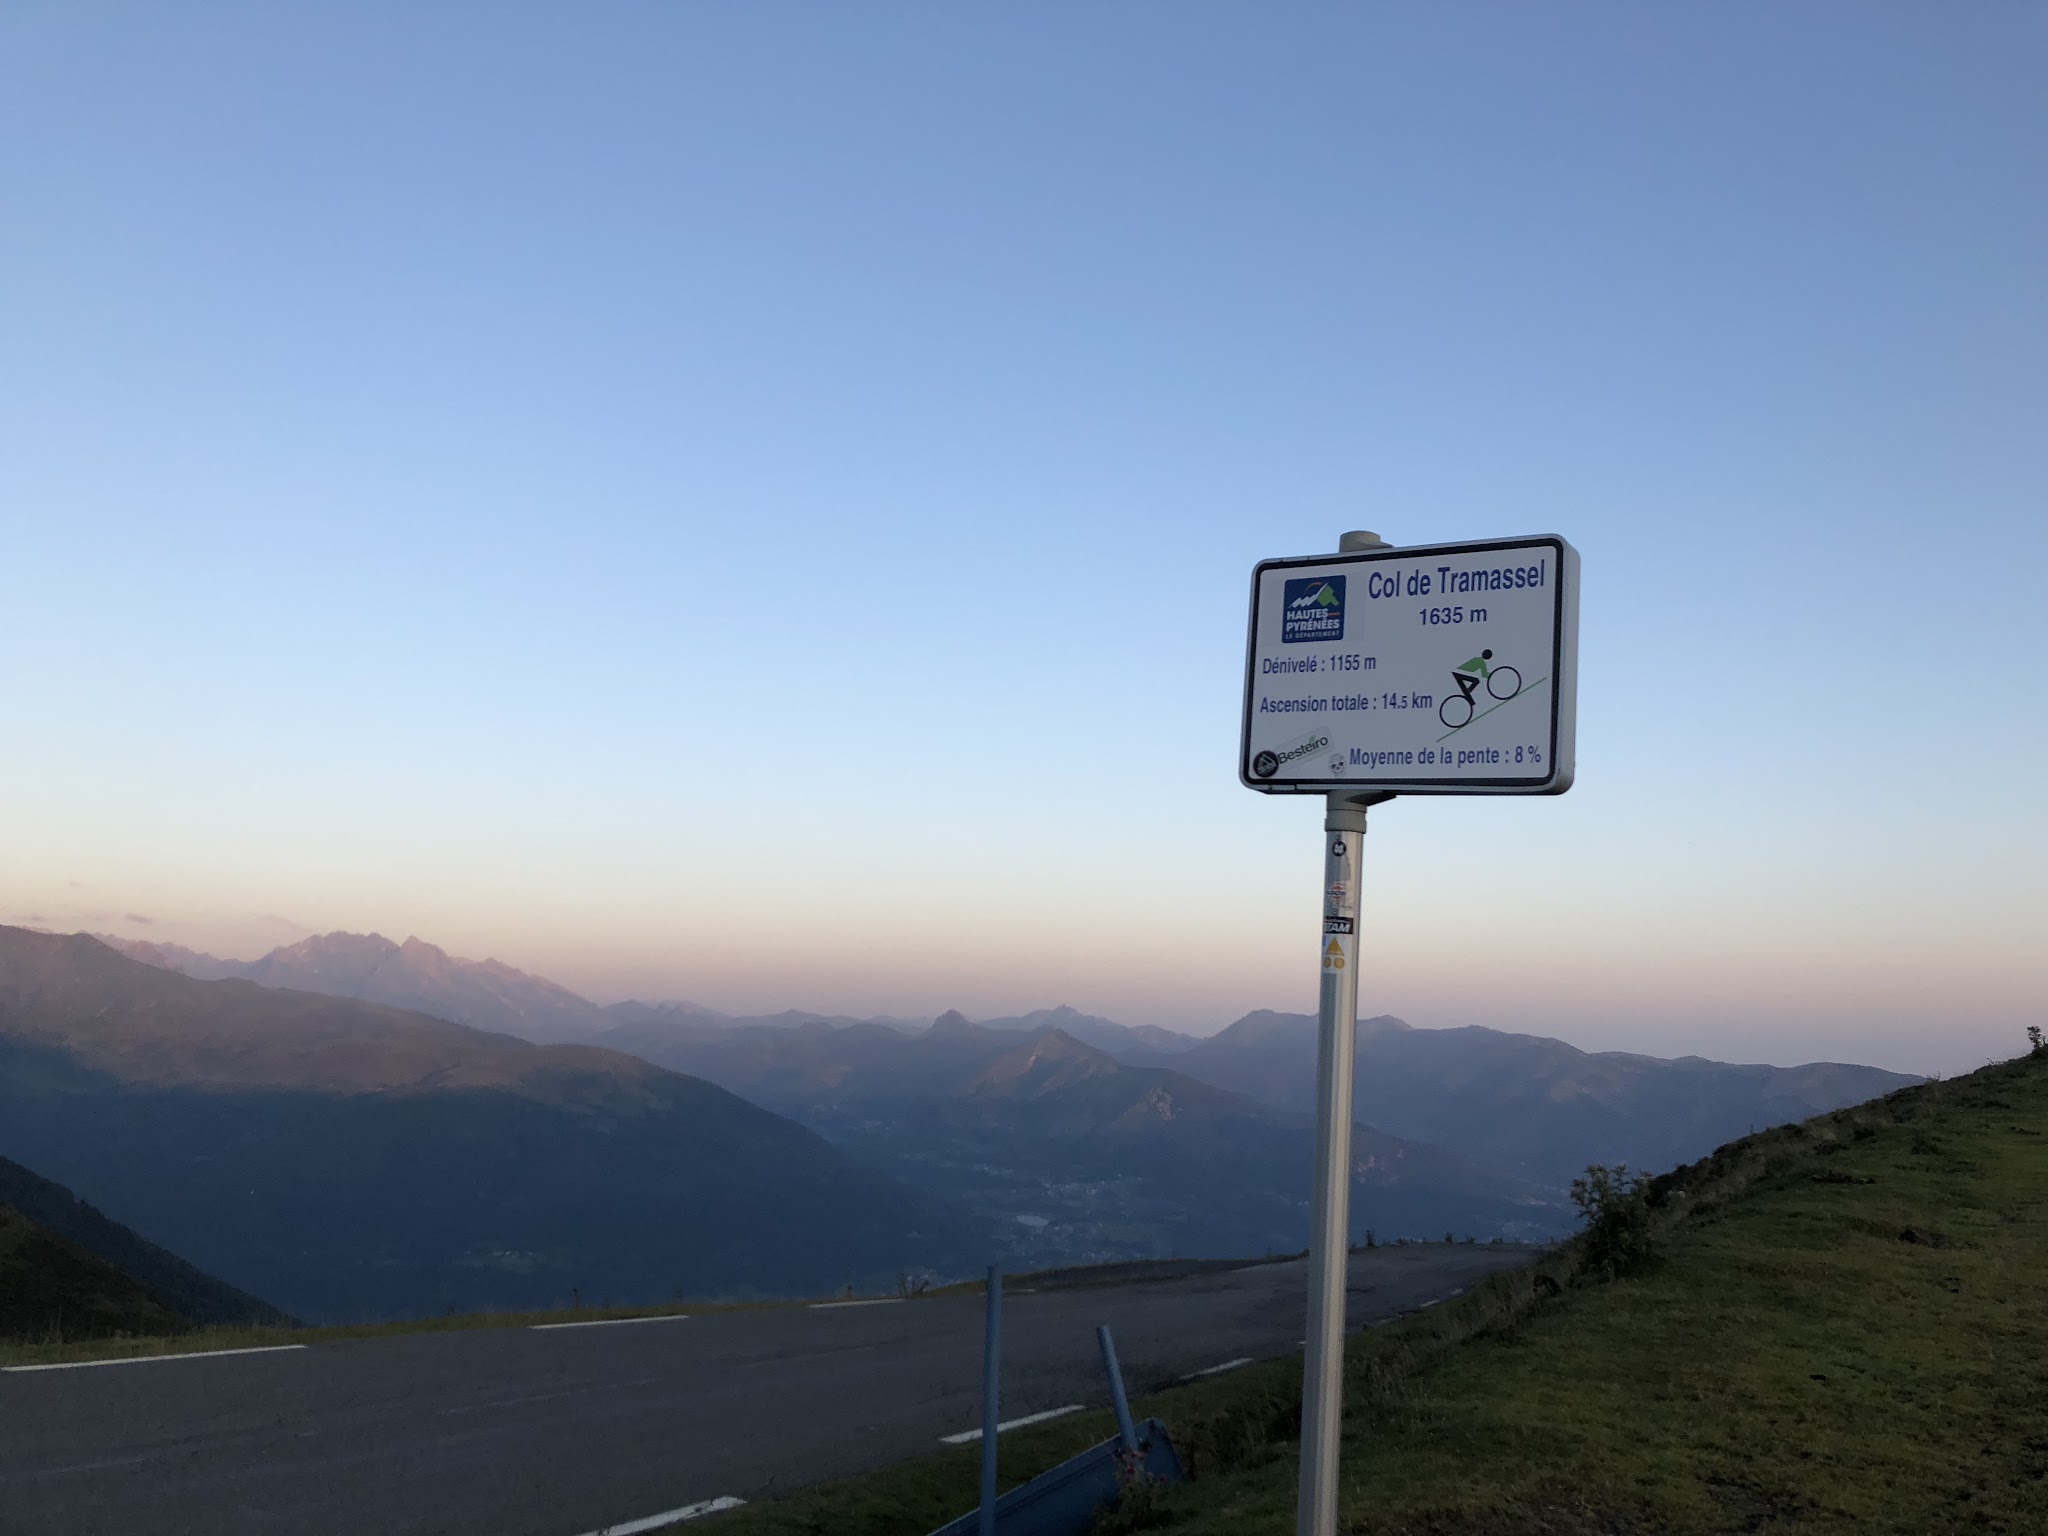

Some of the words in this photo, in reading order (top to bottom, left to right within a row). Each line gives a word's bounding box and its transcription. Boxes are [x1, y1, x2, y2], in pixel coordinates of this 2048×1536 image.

[1369, 571, 1400, 599] Col
[1407, 569, 1431, 596] de
[1438, 559, 1545, 593] Tramassel
[1286, 618, 1340, 632] PYRÉNÉES
[1419, 607, 1463, 625] 1635
[1470, 608, 1487, 622] m
[1263, 655, 1317, 674] Dénivelé
[1330, 654, 1360, 671] 1155
[1364, 656, 1376, 669] m
[1260, 695, 1327, 713] Ascension
[1332, 694, 1369, 711] totale
[1382, 693, 1408, 709] 14.5
[1412, 692, 1433, 709] km
[1277, 736, 1328, 765] Besteiro
[1350, 748, 1412, 769] Moyenne
[1418, 747, 1435, 764] de
[1440, 746, 1452, 764] la
[1457, 748, 1499, 768] pente
[1515, 746, 1523, 763] 8
